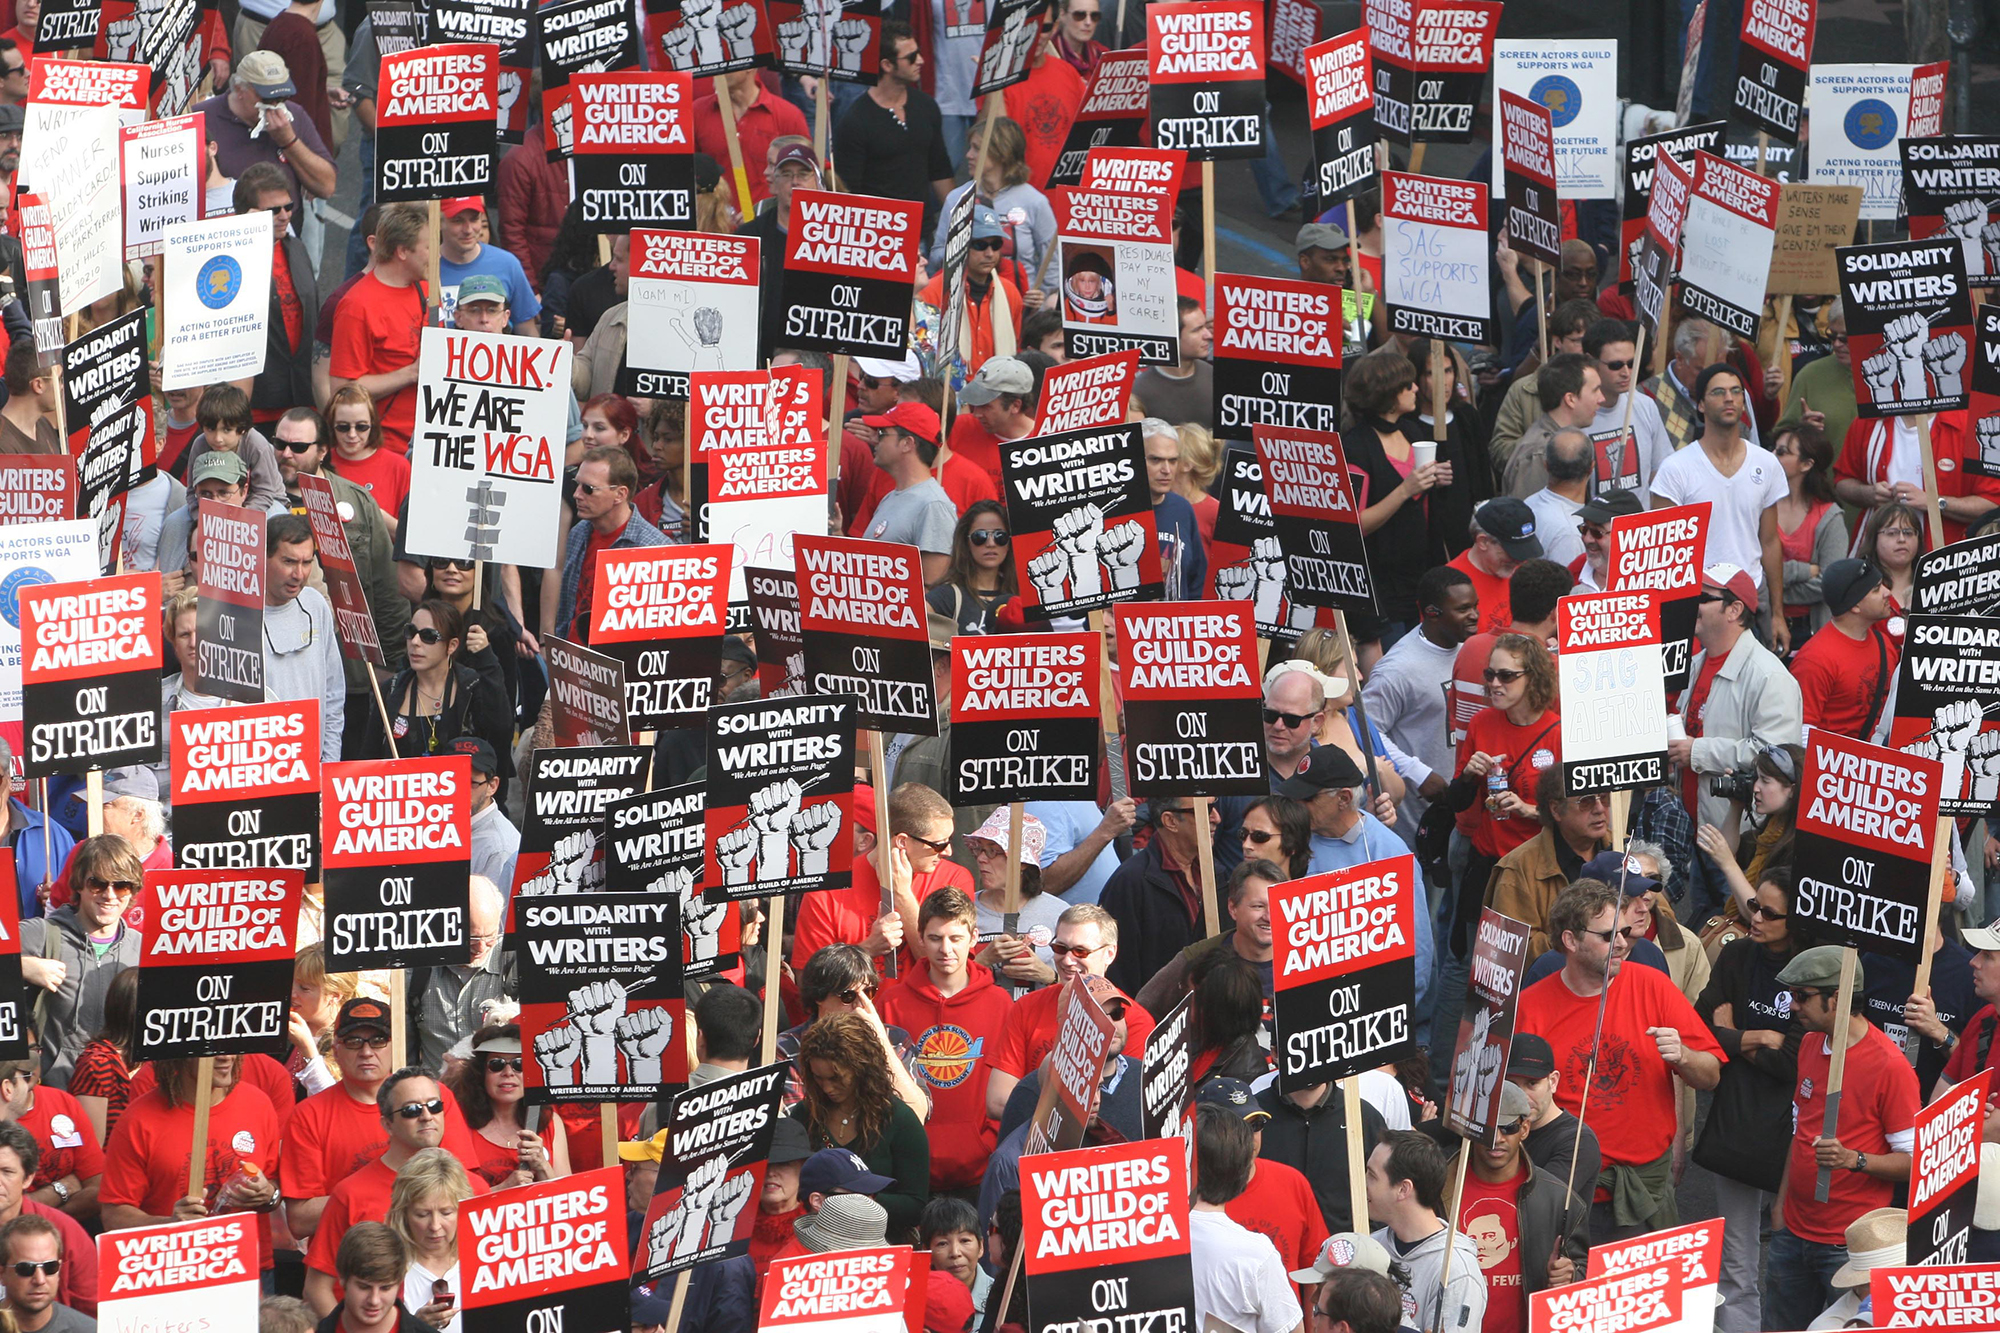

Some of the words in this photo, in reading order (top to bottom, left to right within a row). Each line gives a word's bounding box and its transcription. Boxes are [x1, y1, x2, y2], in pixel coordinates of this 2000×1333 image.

[1156, 12, 1252, 33] WRITERS
[1160, 35, 1226, 54] GUILD
[1228, 37, 1250, 50] OF
[389, 55, 486, 80] WRITERS
[1156, 52, 1258, 74] AMERICA
[391, 75, 459, 98] GUILD
[461, 78, 483, 92] OF
[384, 92, 490, 117] AMERICA
[1193, 92, 1219, 114] ON
[126, 122, 164, 135] California
[167, 117, 193, 128] Nurses
[138, 126, 182, 138] Association
[1158, 115, 1260, 150] STRIKE
[141, 142, 184, 160] Nurses
[422, 133, 448, 153] ON
[138, 164, 188, 186] Support
[383, 154, 490, 191] STRIKE
[138, 190, 189, 209] Striking
[1789, 206, 1821, 218] SENSE
[140, 215, 186, 232] Writers
[170, 234, 205, 245] SCREEN
[208, 229, 241, 240] ACTORS
[244, 225, 267, 235] GUILD
[186, 242, 232, 254] SUPPORTS
[235, 238, 253, 247] WGA
[1398, 221, 1446, 256] SAG
[1119, 244, 1172, 263] RESIDUALS
[1845, 247, 1954, 272] SOLIDARITY
[1120, 262, 1141, 272] PAY
[1147, 266, 1166, 275] FOR
[1400, 258, 1478, 284] SUPPORTS
[1890, 269, 1912, 278] WITH
[1137, 278, 1151, 288] MY
[1399, 278, 1442, 305] WGA
[1849, 274, 1958, 304] WRITERS
[1122, 292, 1164, 305] HEALTH
[180, 321, 210, 333] ACTING
[213, 313, 254, 327] TOGETHER
[1130, 308, 1165, 323] CARE!
[171, 335, 188, 344] FOR
[199, 329, 229, 340] BETTER
[232, 322, 262, 335] FUTURE
[446, 336, 562, 389] HONK!
[423, 384, 467, 426] WE
[469, 389, 525, 434] ARE
[424, 432, 475, 470] THE
[484, 432, 555, 480] WGA
[30, 587, 147, 623] WRITERS
[36, 616, 117, 648] GUILD
[118, 617, 144, 634] OF
[30, 634, 153, 672] AMERICA
[962, 644, 1085, 669] WRITERS
[968, 668, 1052, 689] GUILD
[1054, 671, 1082, 686] OF
[1573, 649, 1638, 693] SAG
[76, 686, 108, 716] ON
[961, 688, 1090, 711] AMERICA
[1569, 690, 1661, 743] AFTRA
[31, 711, 155, 763] STRIKE
[1006, 729, 1040, 752] ON
[959, 755, 1090, 793] STRIKE
[1816, 744, 1928, 796] WRITERS
[332, 770, 456, 801] WRITERS
[1816, 774, 1895, 815] GUILD
[1895, 803, 1921, 821] OF
[338, 802, 424, 829] GUILD
[426, 803, 453, 823] OF
[1806, 797, 1925, 849] AMERICA
[332, 824, 462, 854] AMERICA
[1842, 856, 1874, 889] ON
[380, 876, 414, 905] ON
[1279, 872, 1399, 923] WRITERS
[526, 904, 668, 927] SOLIDARITY
[1795, 876, 1918, 944] STRIKE
[332, 906, 462, 955] STRIKE
[584, 927, 611, 936] WITH
[1287, 906, 1370, 948] GUILD
[1372, 904, 1396, 923] OF
[528, 936, 668, 965] WRITERS
[1283, 923, 1405, 976] AMERICA
[1329, 984, 1361, 1018] ON
[952, 1025, 972, 1045] SUNDAY
[1287, 1004, 1408, 1075] STRIKE
[924, 1072, 942, 1086] COAST
[952, 1070, 970, 1086] COAST
[1032, 1156, 1170, 1199] WRITERS
[468, 1186, 608, 1237] WRITERS
[1041, 1190, 1137, 1226] GUILD
[1138, 1192, 1169, 1213] OF
[476, 1223, 574, 1264] GUILD
[575, 1221, 606, 1244] OF
[1036, 1214, 1180, 1260] AMERICA
[470, 1242, 618, 1294] AMERICA
[1091, 1277, 1129, 1310] ON
